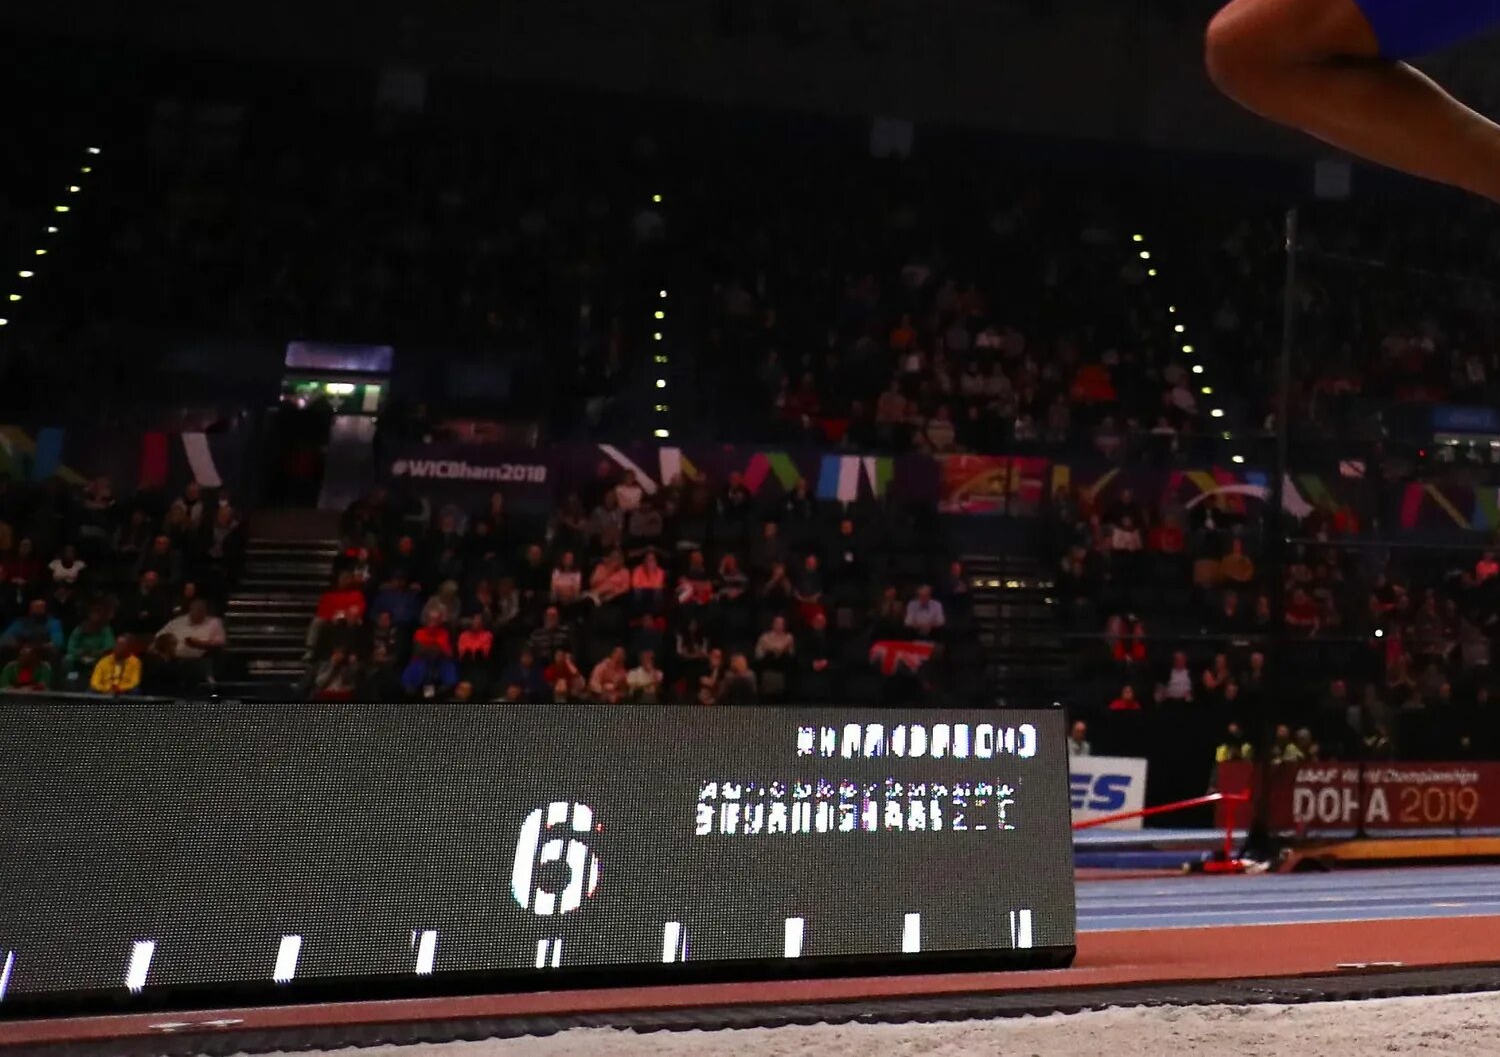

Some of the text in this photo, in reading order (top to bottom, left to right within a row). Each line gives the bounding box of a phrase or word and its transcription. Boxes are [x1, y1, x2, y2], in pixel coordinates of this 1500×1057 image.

[1292, 787, 1479, 823] DOHA 2019
[508, 799, 604, 918] 6
